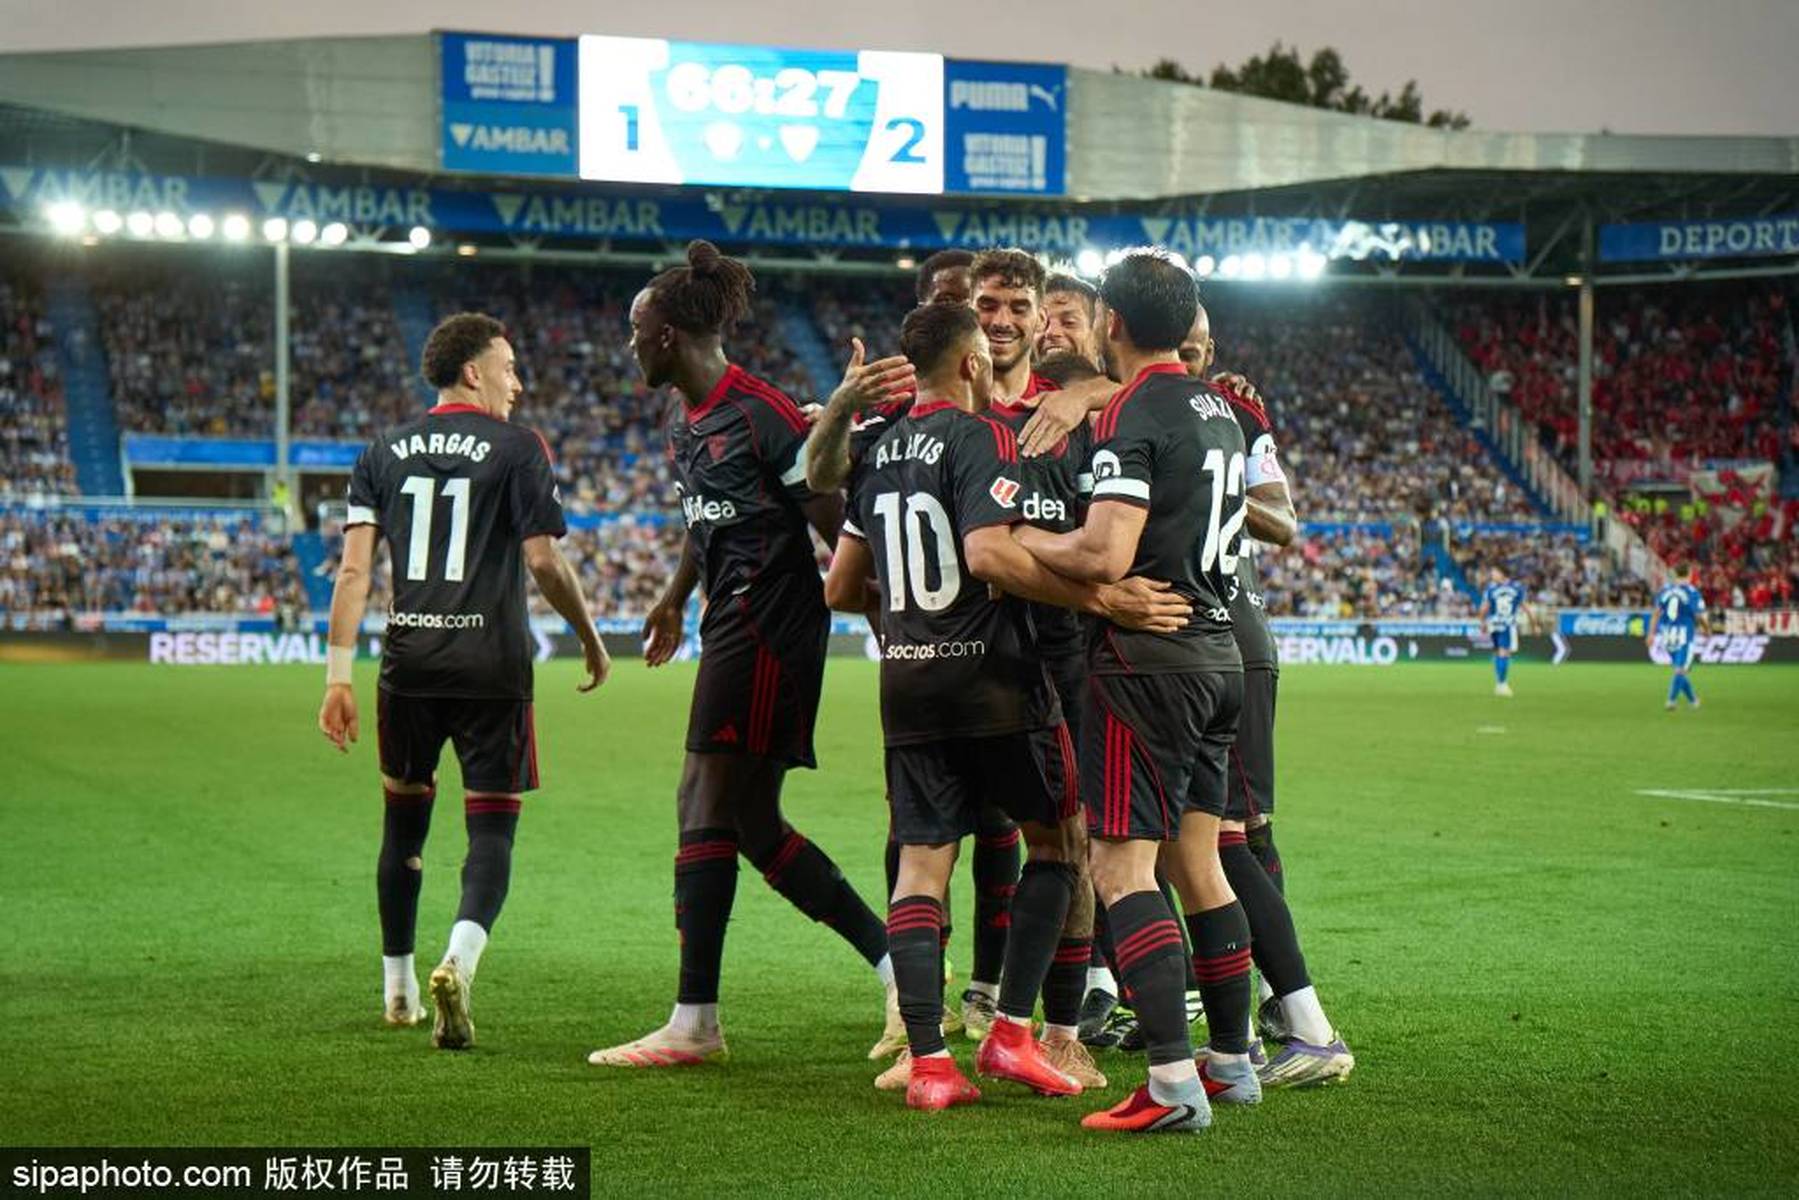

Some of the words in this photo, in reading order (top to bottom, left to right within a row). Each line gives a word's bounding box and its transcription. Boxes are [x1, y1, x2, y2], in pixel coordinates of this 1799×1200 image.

[666, 62, 860, 119] 66:27
[471, 125, 570, 155] AMBAR
[618, 105, 639, 151] 1
[885, 117, 927, 164] 2
[36, 168, 192, 216] AMBAR
[286, 184, 435, 226] AMBAR
[523, 194, 664, 237] AMBAR
[747, 206, 883, 245] AMBAR
[961, 212, 1099, 250] AMBAR
[390, 432, 491, 463] VARGAS
[400, 475, 471, 582] 11
[1200, 448, 1247, 576] 12
[873, 491, 962, 612] 10
[150, 632, 329, 665] RESERVAL
[886, 640, 985, 660] socios.com
